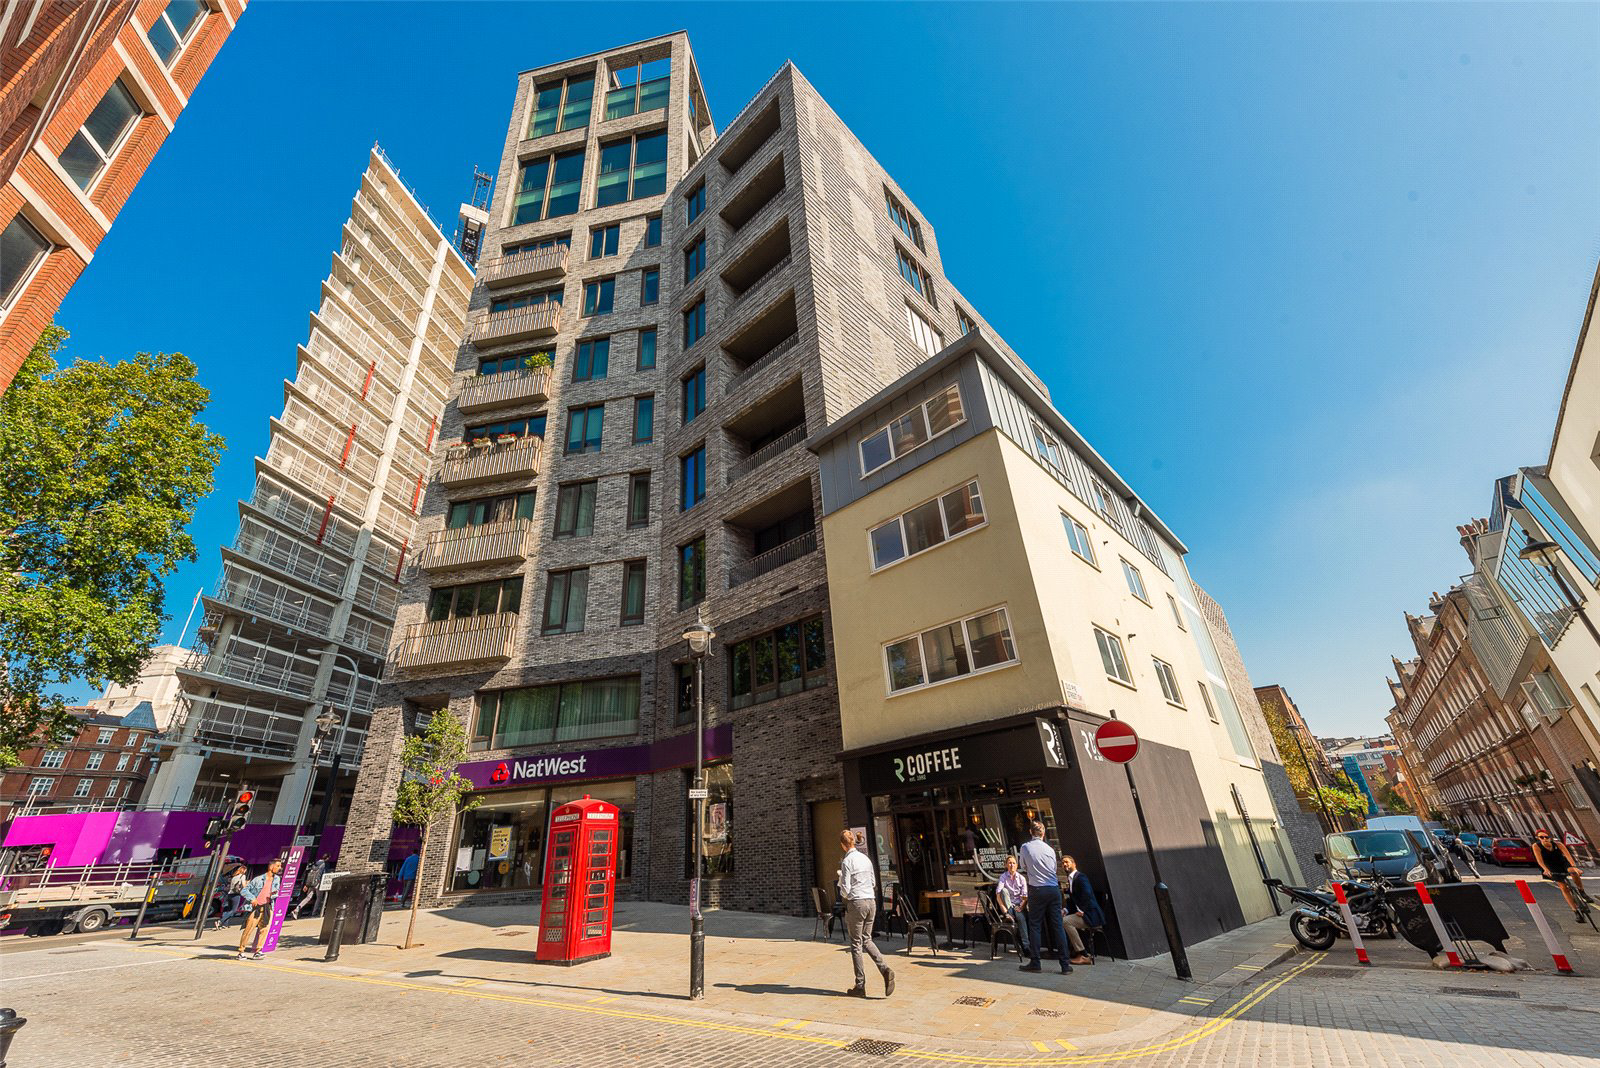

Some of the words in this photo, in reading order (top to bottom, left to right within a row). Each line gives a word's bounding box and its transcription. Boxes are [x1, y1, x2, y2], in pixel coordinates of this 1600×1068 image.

[513, 755, 587, 779] NatWest
[906, 747, 962, 776] COFFEE
[978, 847, 996, 855] SERVING
[981, 861, 994, 869] SINCE
